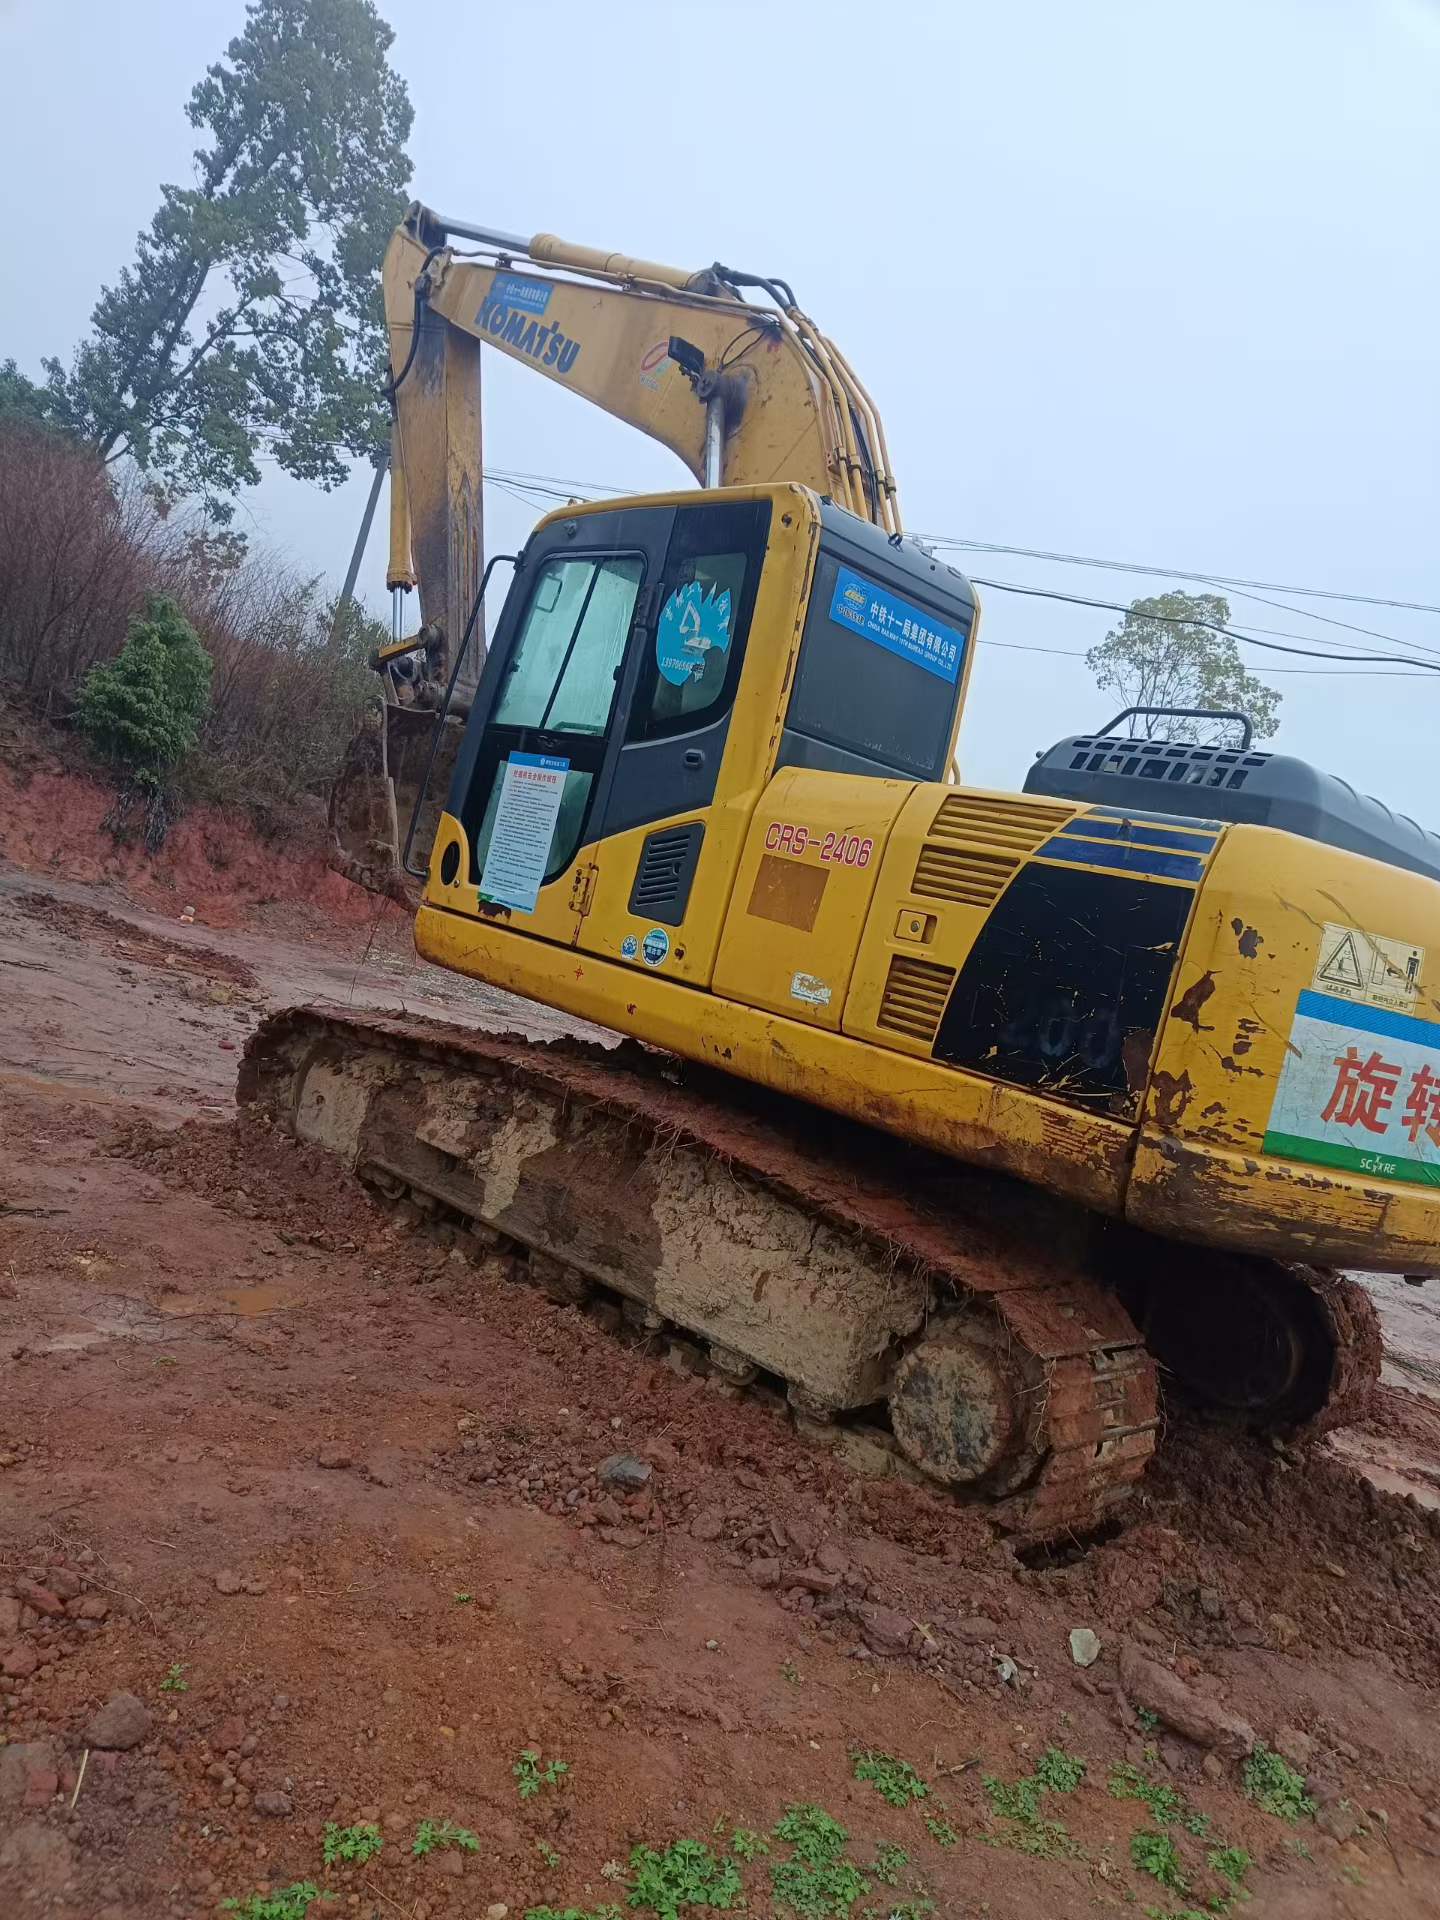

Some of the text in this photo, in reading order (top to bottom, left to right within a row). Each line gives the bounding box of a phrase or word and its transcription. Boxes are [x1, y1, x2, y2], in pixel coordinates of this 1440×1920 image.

[474, 297, 581, 374] KOMATSU
[870, 601, 957, 663] 中铁十一局集团有限公司
[765, 822, 873, 868] CRS-2406
